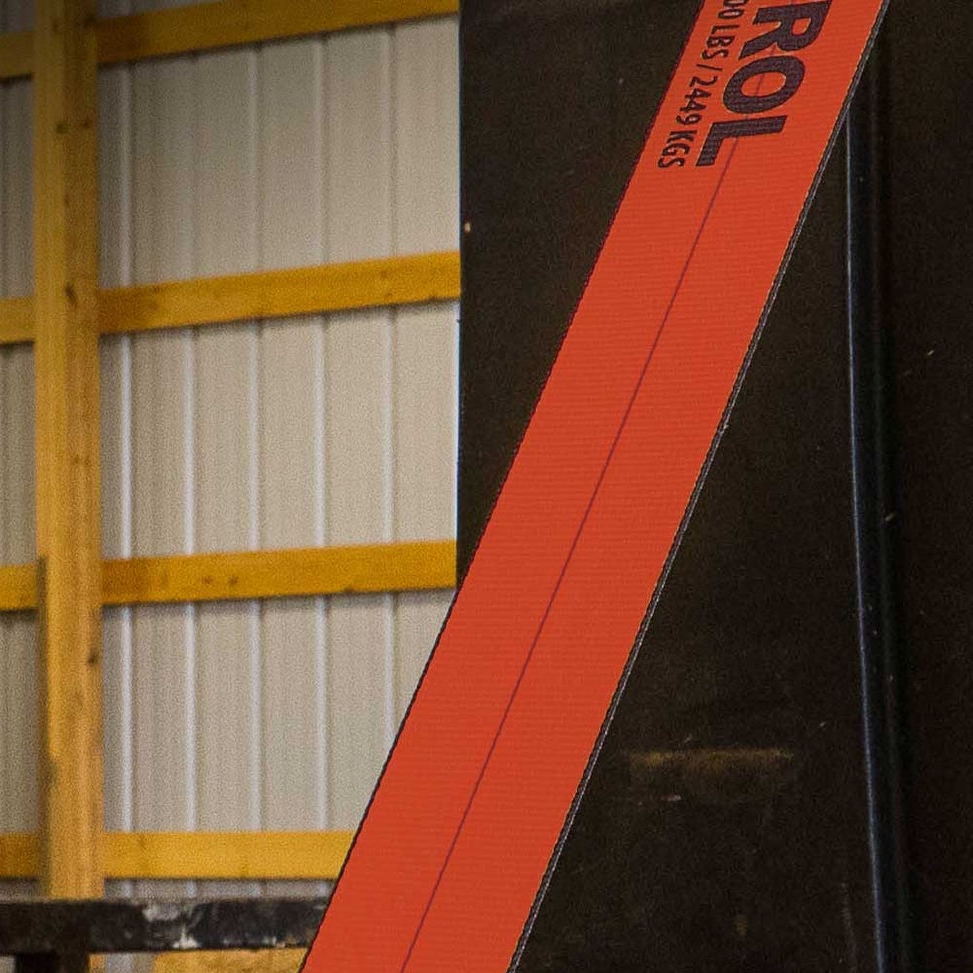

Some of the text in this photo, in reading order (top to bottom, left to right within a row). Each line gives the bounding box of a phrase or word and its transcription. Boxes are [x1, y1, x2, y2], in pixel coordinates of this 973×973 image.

[702, 25, 739, 60] LBS
[696, 63, 723, 72] /
[696, 0, 830, 166] ROL
[676, 75, 718, 126] 2449
[657, 130, 698, 168] KGS
